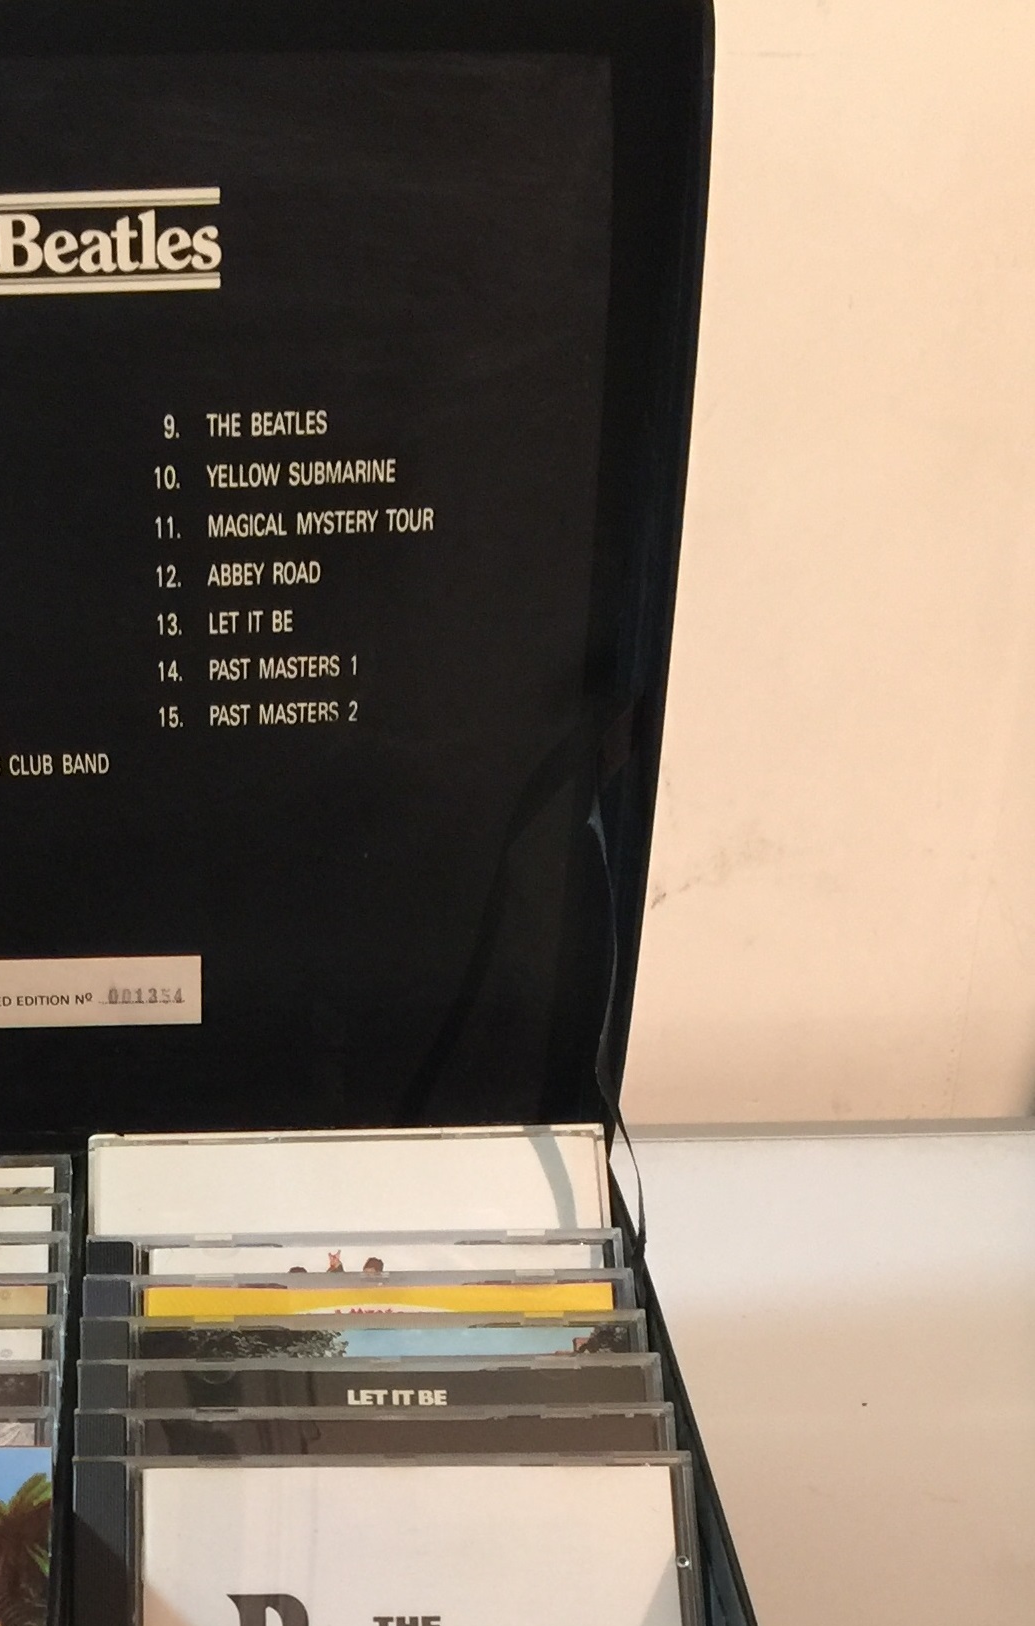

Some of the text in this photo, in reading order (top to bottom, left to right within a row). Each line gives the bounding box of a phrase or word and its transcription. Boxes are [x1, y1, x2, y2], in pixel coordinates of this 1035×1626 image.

[163, 409, 328, 440] 9. THE BEATLES
[154, 458, 396, 490] 10. YELLOW SUBMARINE
[155, 507, 434, 539] 11. MAGICAL MYSTERY TOUR
[156, 560, 321, 589] 12. ABBEY ROAD
[157, 609, 293, 636] 13. LET IT BE
[158, 654, 357, 682] 14. PAST MASTERS 1
[158, 700, 358, 729] 15. PAST MASTERS 2
[9, 753, 54, 776] CLUB
[62, 752, 110, 775] BAND
[16, 994, 70, 1007] EDITION
[347, 1389, 448, 1406] LET IT BE
